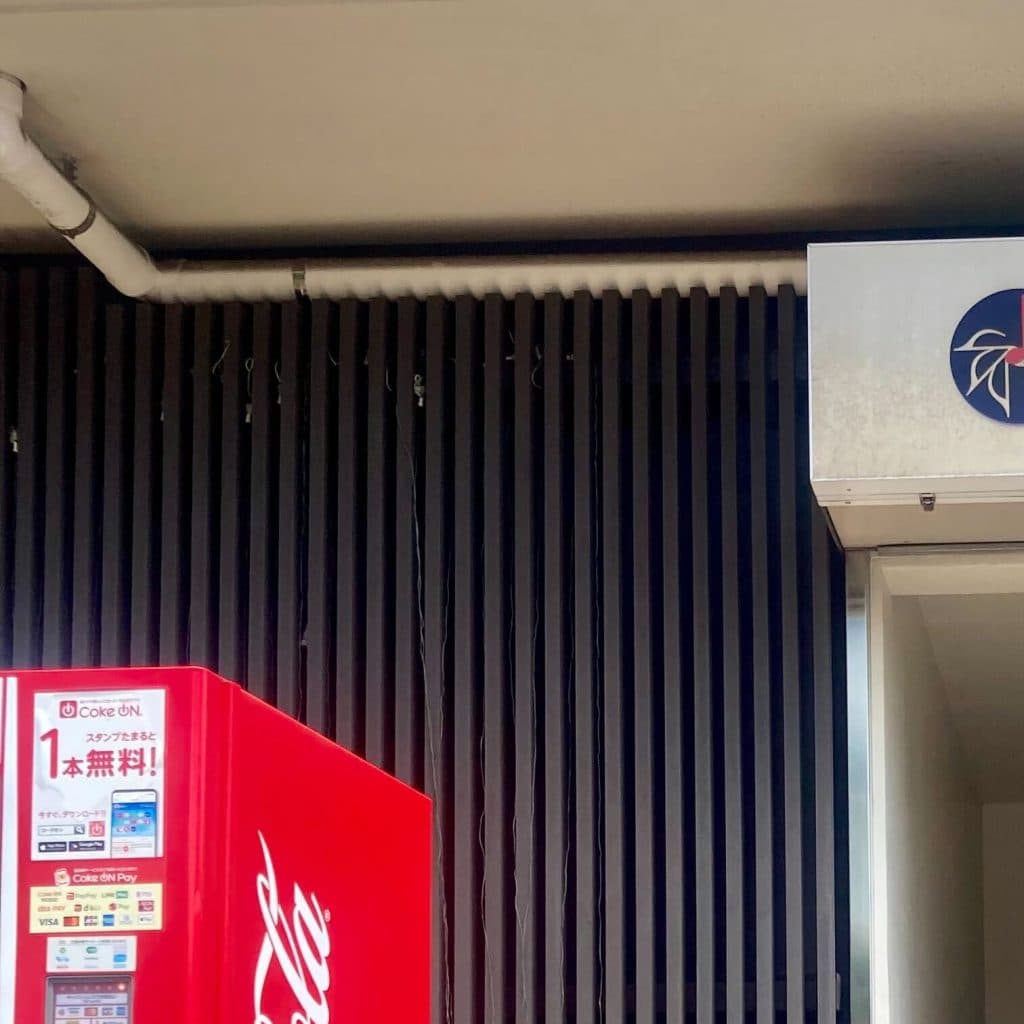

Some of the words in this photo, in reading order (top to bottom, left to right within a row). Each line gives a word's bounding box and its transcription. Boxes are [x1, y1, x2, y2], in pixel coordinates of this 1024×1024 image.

[79, 705, 115, 718] Coke
[86, 731, 157, 743] スタンプたまると
